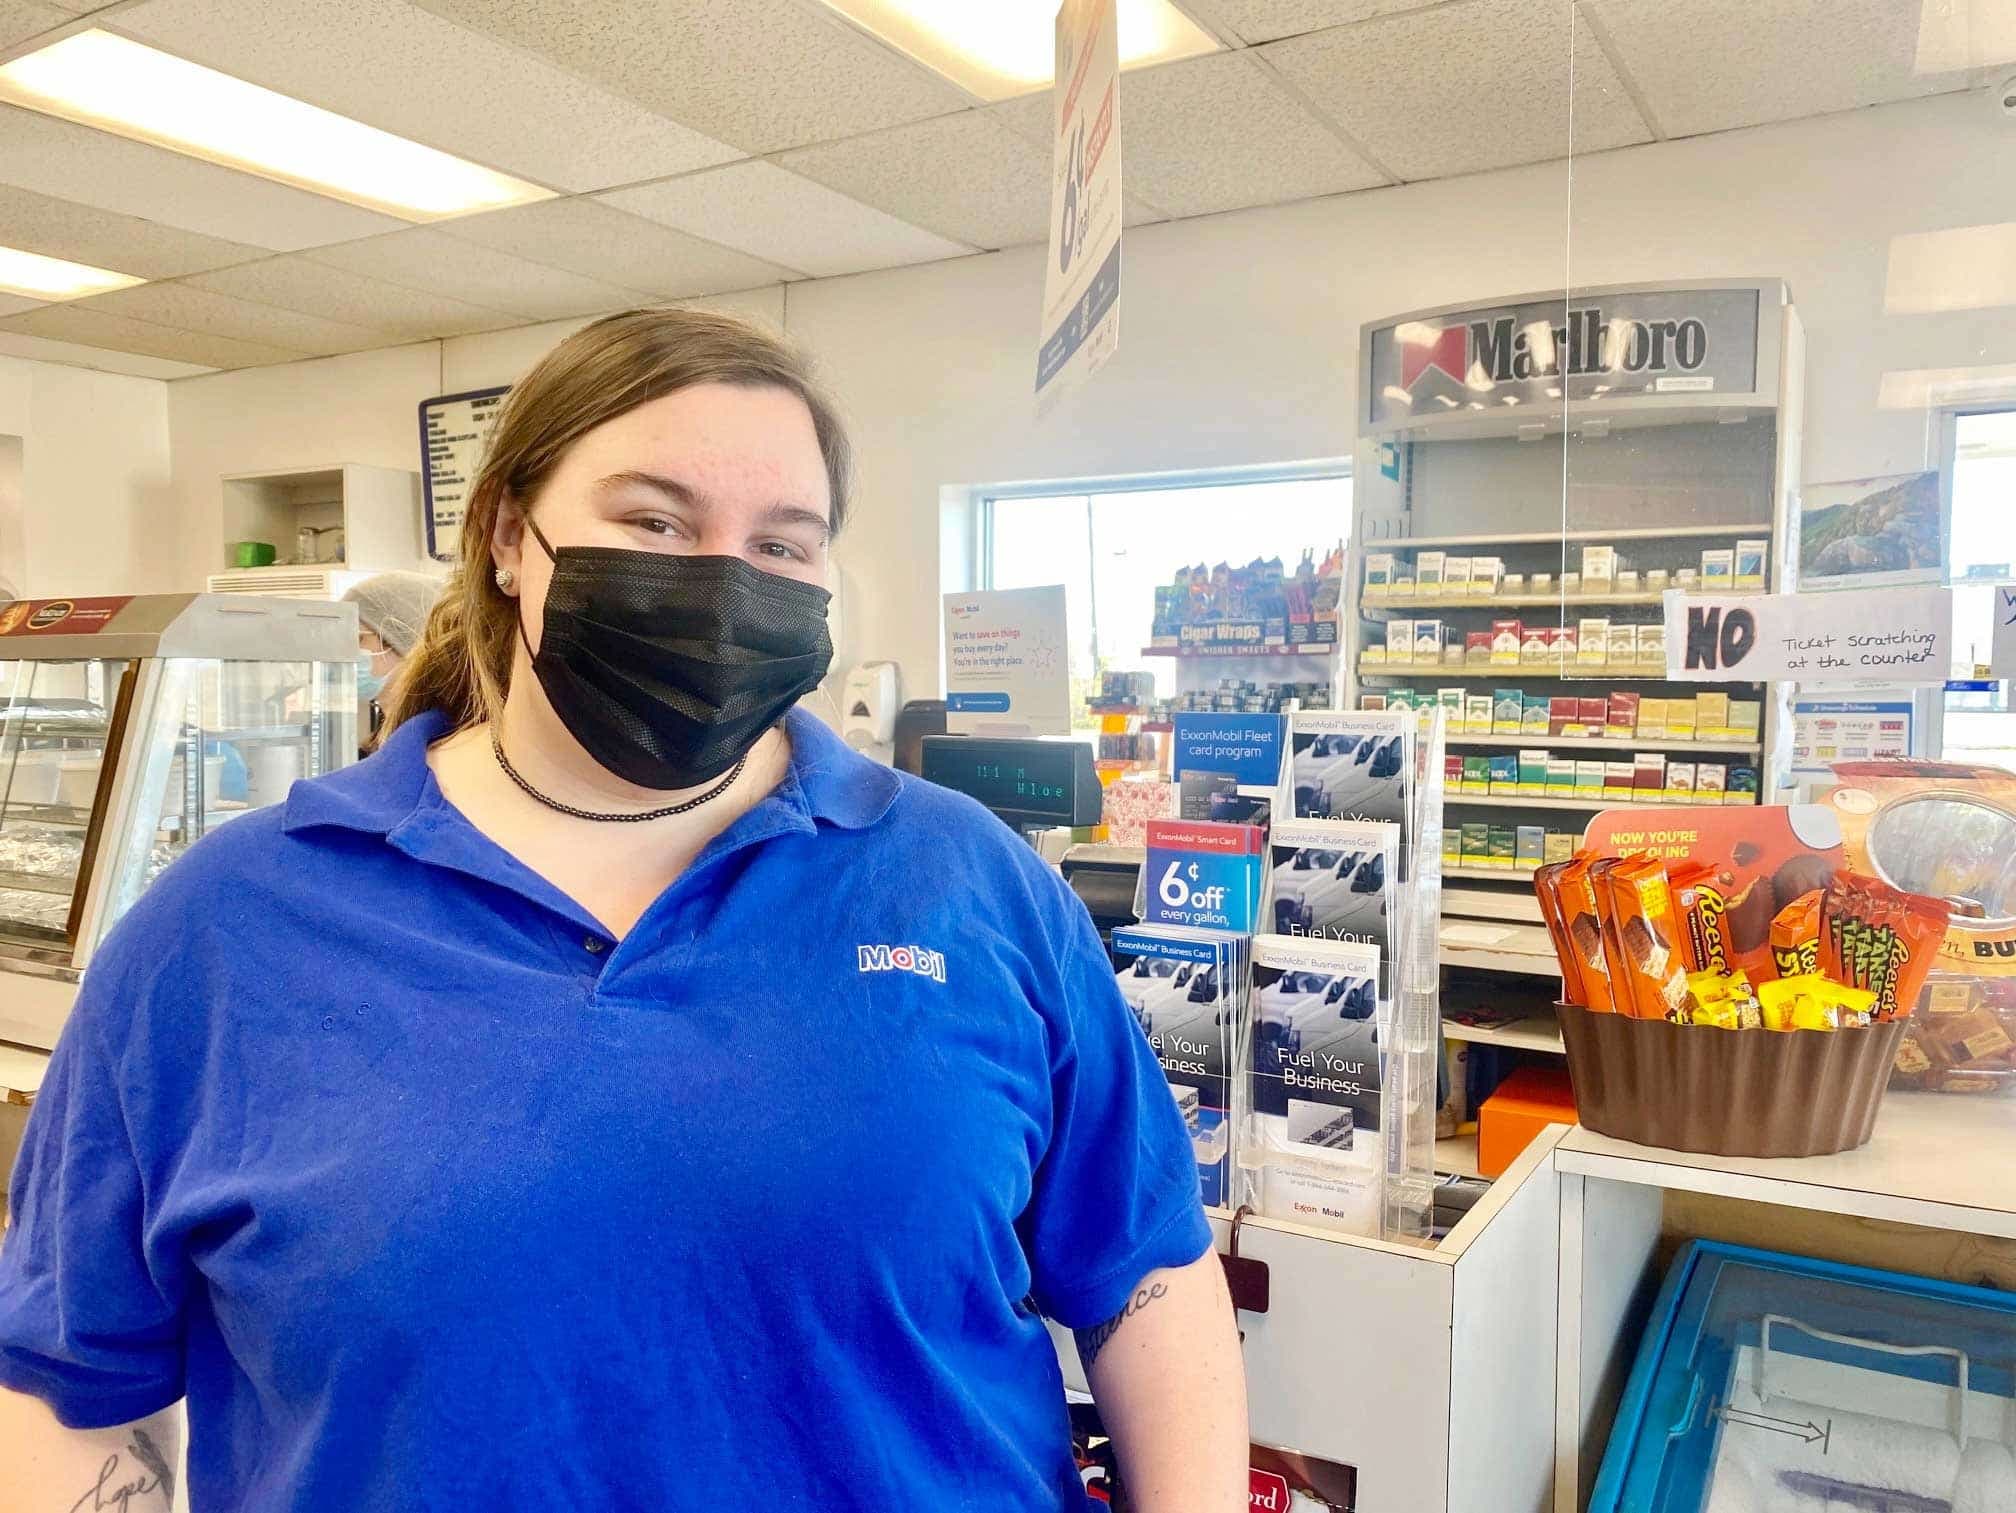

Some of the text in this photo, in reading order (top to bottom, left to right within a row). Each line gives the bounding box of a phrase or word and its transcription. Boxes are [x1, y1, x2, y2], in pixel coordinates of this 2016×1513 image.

[1469, 308, 1707, 384] Marlboro
[953, 631, 968, 640] Want
[976, 631, 990, 639] save
[1000, 629, 1021, 640] things
[1181, 623, 1260, 643] Cigar Wraps
[1685, 606, 1755, 670] NO
[953, 646, 964, 655] you
[965, 645, 975, 655] buy
[976, 645, 993, 655] every
[1783, 637, 1836, 652] Ticket
[1787, 650, 1936, 669] at the counter
[1342, 720, 1374, 730] Business
[1376, 721, 1395, 731] Card
[1181, 729, 1272, 743] ExxonMobil Fleet
[1189, 744, 1262, 761] card program
[1198, 835, 1218, 845] Smart
[1219, 836, 1236, 846] Card
[1322, 835, 1356, 846] Business
[1357, 838, 1377, 848] Card
[1610, 830, 1698, 844] NOW YOU'RE
[1190, 886, 1225, 910] off
[1160, 909, 1230, 926] every gallon,
[1332, 927, 1374, 945] Your
[1161, 945, 1193, 957] Business
[1193, 949, 1212, 959] Card
[858, 944, 947, 984] Mobil
[1311, 958, 1346, 970] Business
[1347, 962, 1367, 973] Card
[1881, 937, 1910, 1015] Reese's
[1170, 1035, 1209, 1056] Your
[1277, 1047, 1365, 1075] Fuel Your
[1283, 1067, 1361, 1096] Business
[1294, 1202, 1344, 1218] Exxon Mobil
